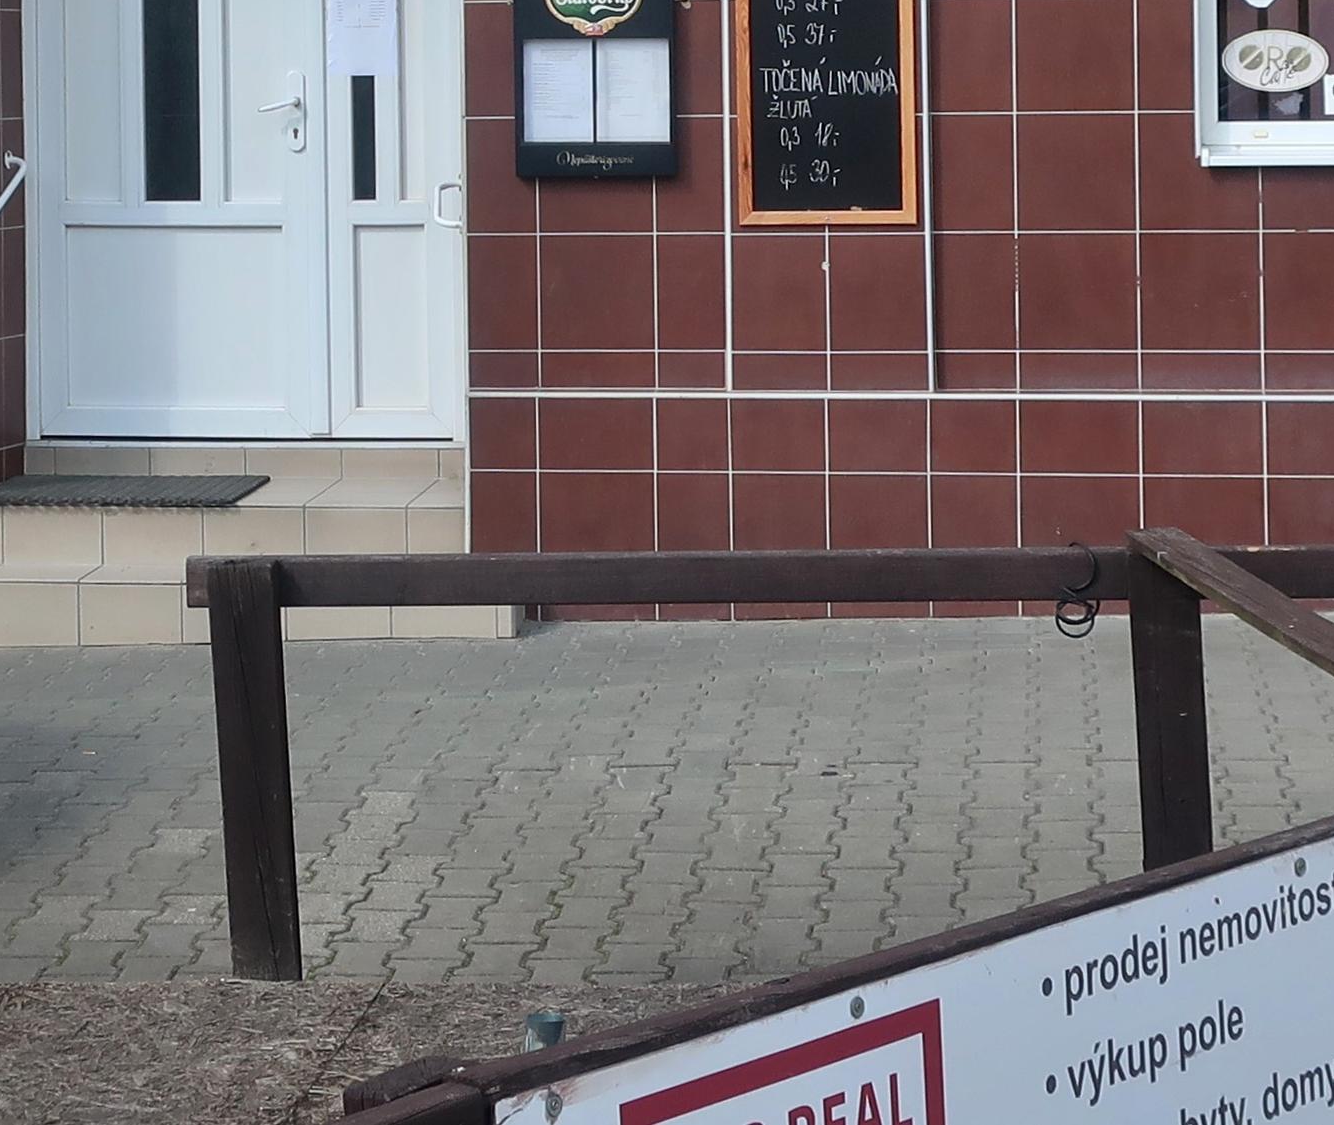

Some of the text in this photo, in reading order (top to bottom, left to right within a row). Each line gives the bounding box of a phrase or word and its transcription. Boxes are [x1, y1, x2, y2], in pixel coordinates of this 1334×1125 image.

[759, 56, 898, 96] TOČENÁ LIMONÁDA
[767, 94, 818, 119] ŽLUTÁ
[780, 125, 801, 151] 0,3
[1064, 924, 1167, 1016] prodej
[1067, 999, 1244, 1107] výkup pole
